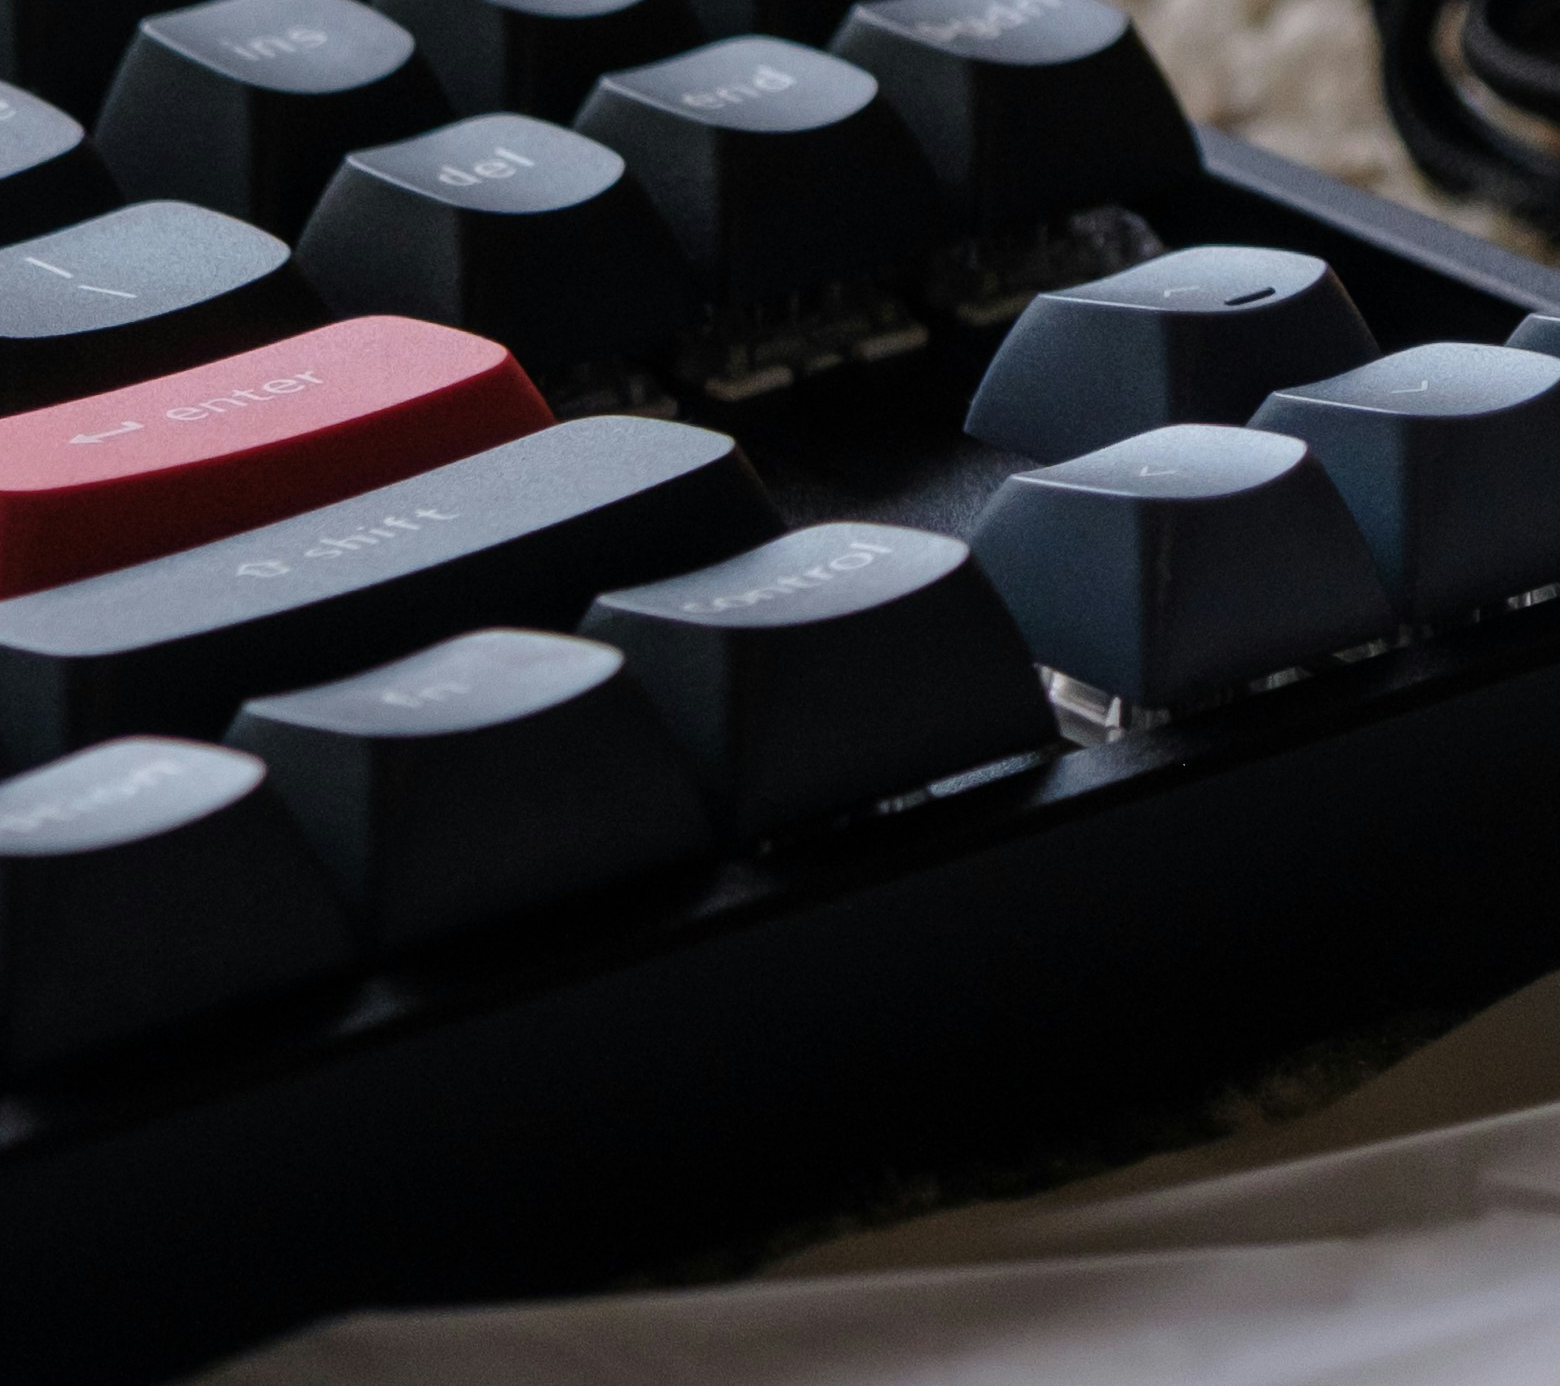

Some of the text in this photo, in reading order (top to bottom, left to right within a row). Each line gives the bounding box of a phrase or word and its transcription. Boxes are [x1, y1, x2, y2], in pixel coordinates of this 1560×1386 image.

[232, 25, 330, 61] ins
[682, 65, 800, 110] end
[436, 147, 536, 191] del
[165, 370, 325, 422] enter
[303, 507, 460, 560] shift
[680, 541, 894, 613] control
[380, 677, 477, 709] fn
